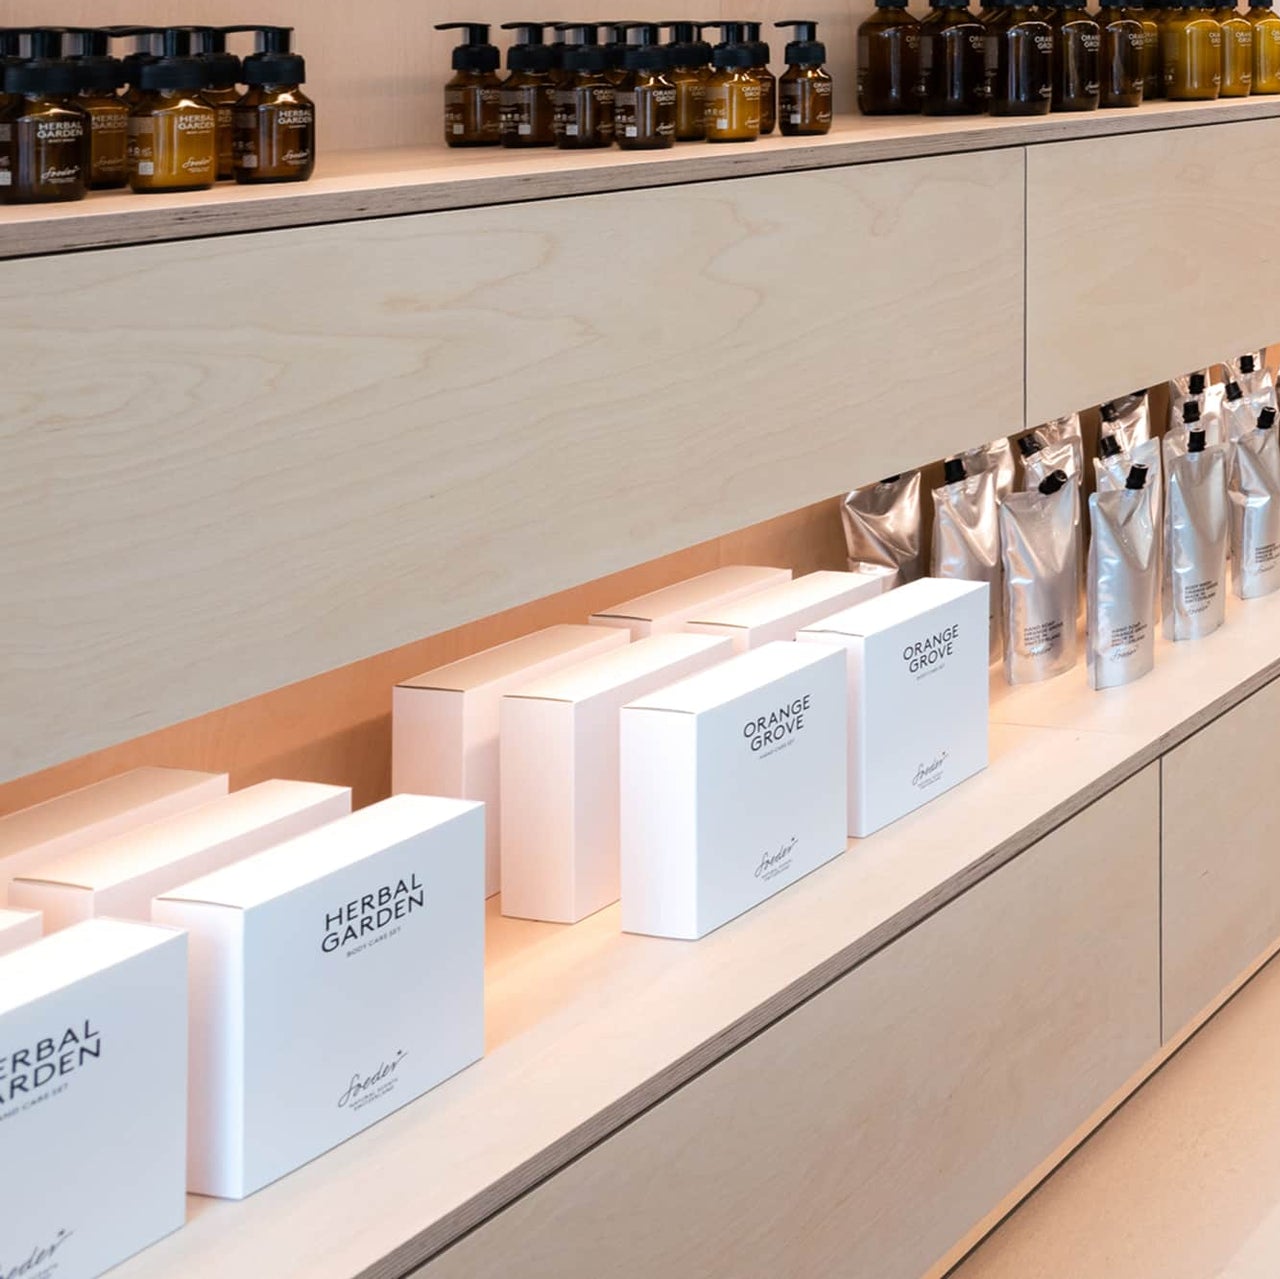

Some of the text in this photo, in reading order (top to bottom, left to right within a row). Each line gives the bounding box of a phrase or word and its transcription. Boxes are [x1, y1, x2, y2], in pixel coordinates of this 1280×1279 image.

[36, 128, 83, 138] GARDEN
[38, 121, 82, 130] HERBAL
[903, 624, 959, 660] ORANGE
[909, 642, 953, 673] GROVE
[743, 694, 810, 738] ORANGE
[751, 714, 804, 751] GROVE
[321, 889, 424, 953] GARDEN
[325, 873, 423, 932] HERBAL
[0, 1019, 100, 1080] RBAL
[0, 1037, 101, 1105] RDEN
